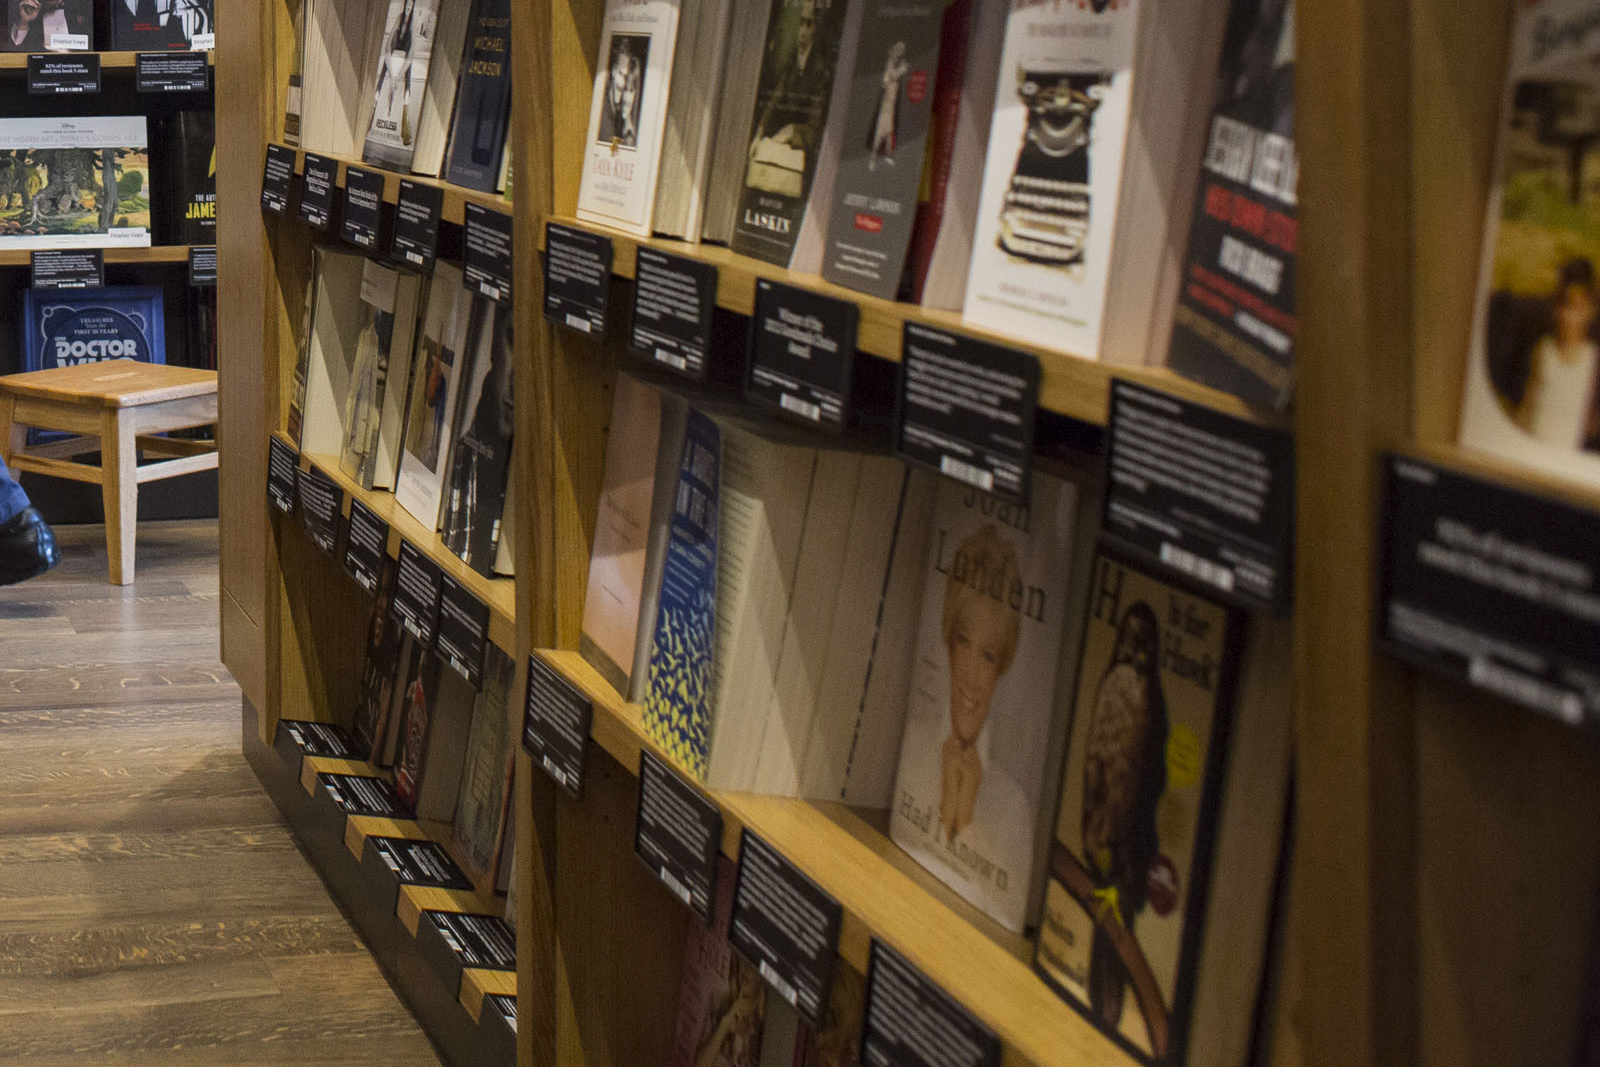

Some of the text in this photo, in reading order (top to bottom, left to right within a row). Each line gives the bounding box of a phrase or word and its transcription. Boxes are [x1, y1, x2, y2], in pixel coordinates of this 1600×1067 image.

[473, 37, 505, 51] MICHAEL
[468, 62, 502, 76] JACKSON
[744, 209, 791, 234] LASKIN
[55, 339, 138, 357] DOCTOR
[934, 531, 1047, 625] Lunden
